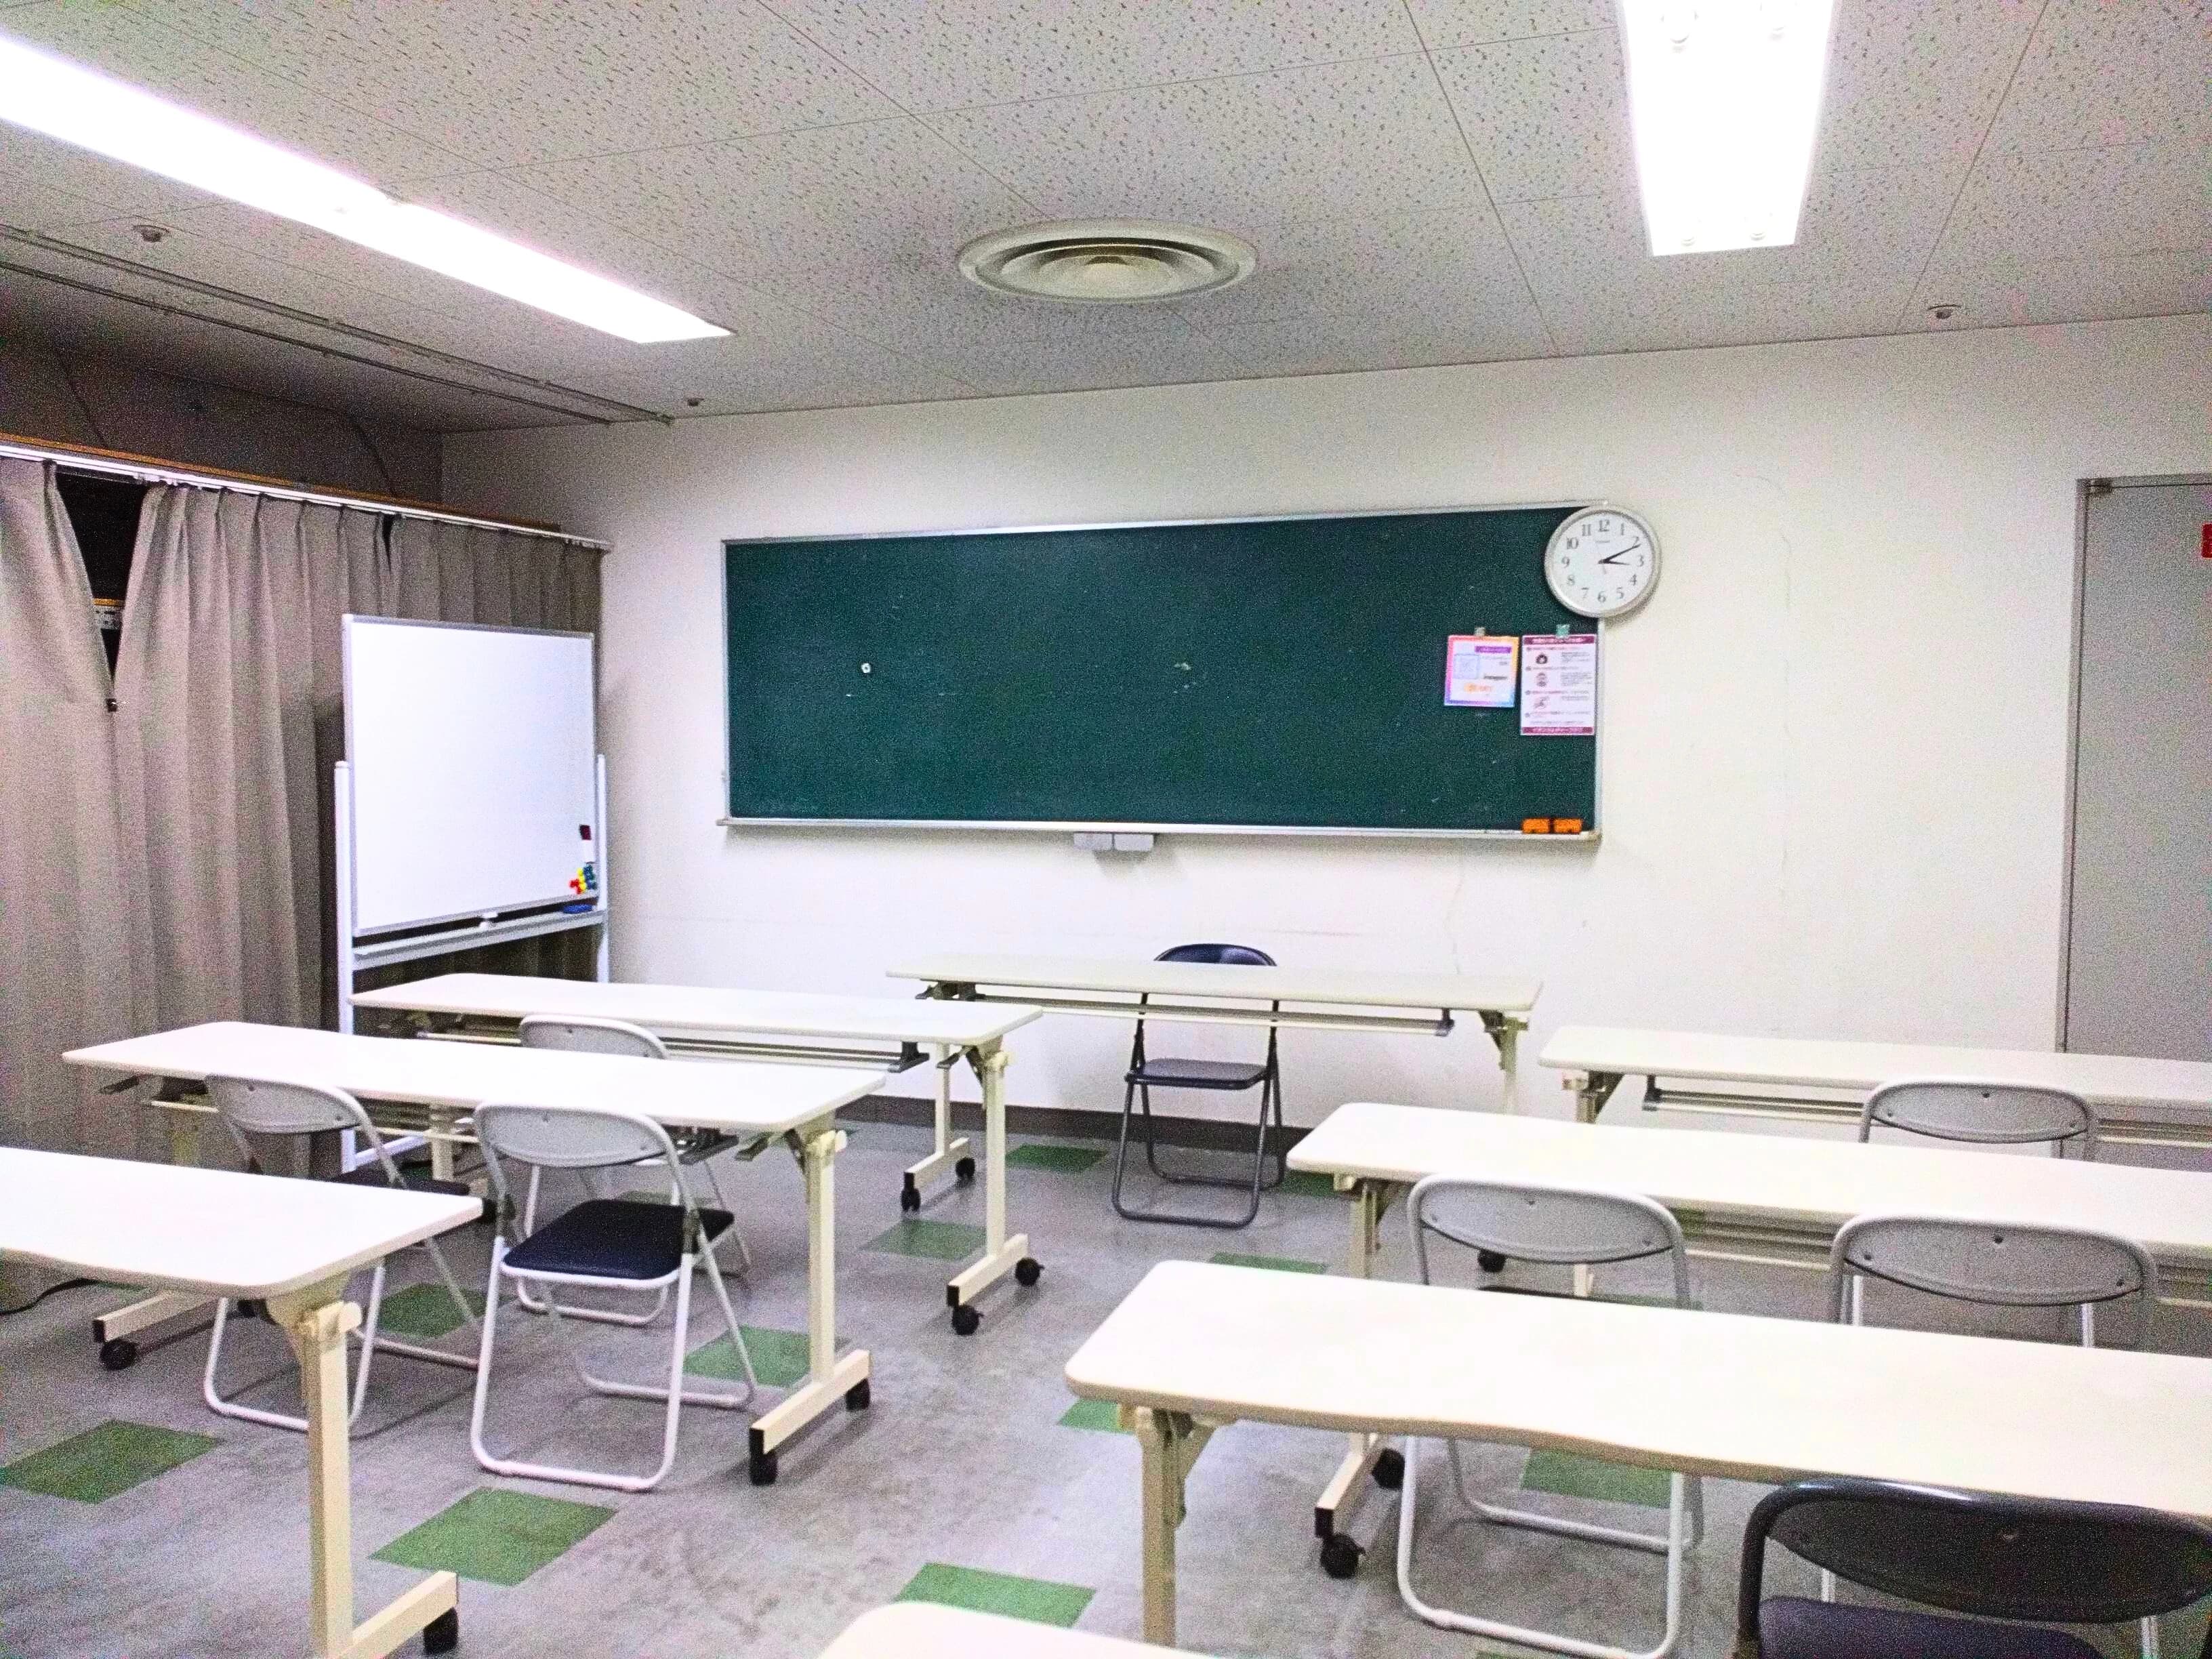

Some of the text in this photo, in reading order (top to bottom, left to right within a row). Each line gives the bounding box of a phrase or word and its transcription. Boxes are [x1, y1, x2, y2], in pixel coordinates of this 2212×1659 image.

[1582, 524, 1591, 536] 11
[1599, 519, 1610, 532] 12
[1620, 523, 1624, 535] 1
[1567, 537, 1578, 550] 10
[1631, 536, 1639, 547] 2
[1561, 556, 1570, 568] 9
[1637, 555, 1644, 567] 3
[1567, 575, 1575, 586] 8
[1629, 574, 1637, 586] 4
[1581, 587, 1589, 598] 7
[1597, 591, 1606, 602] 6
[1616, 587, 1624, 599] 5
